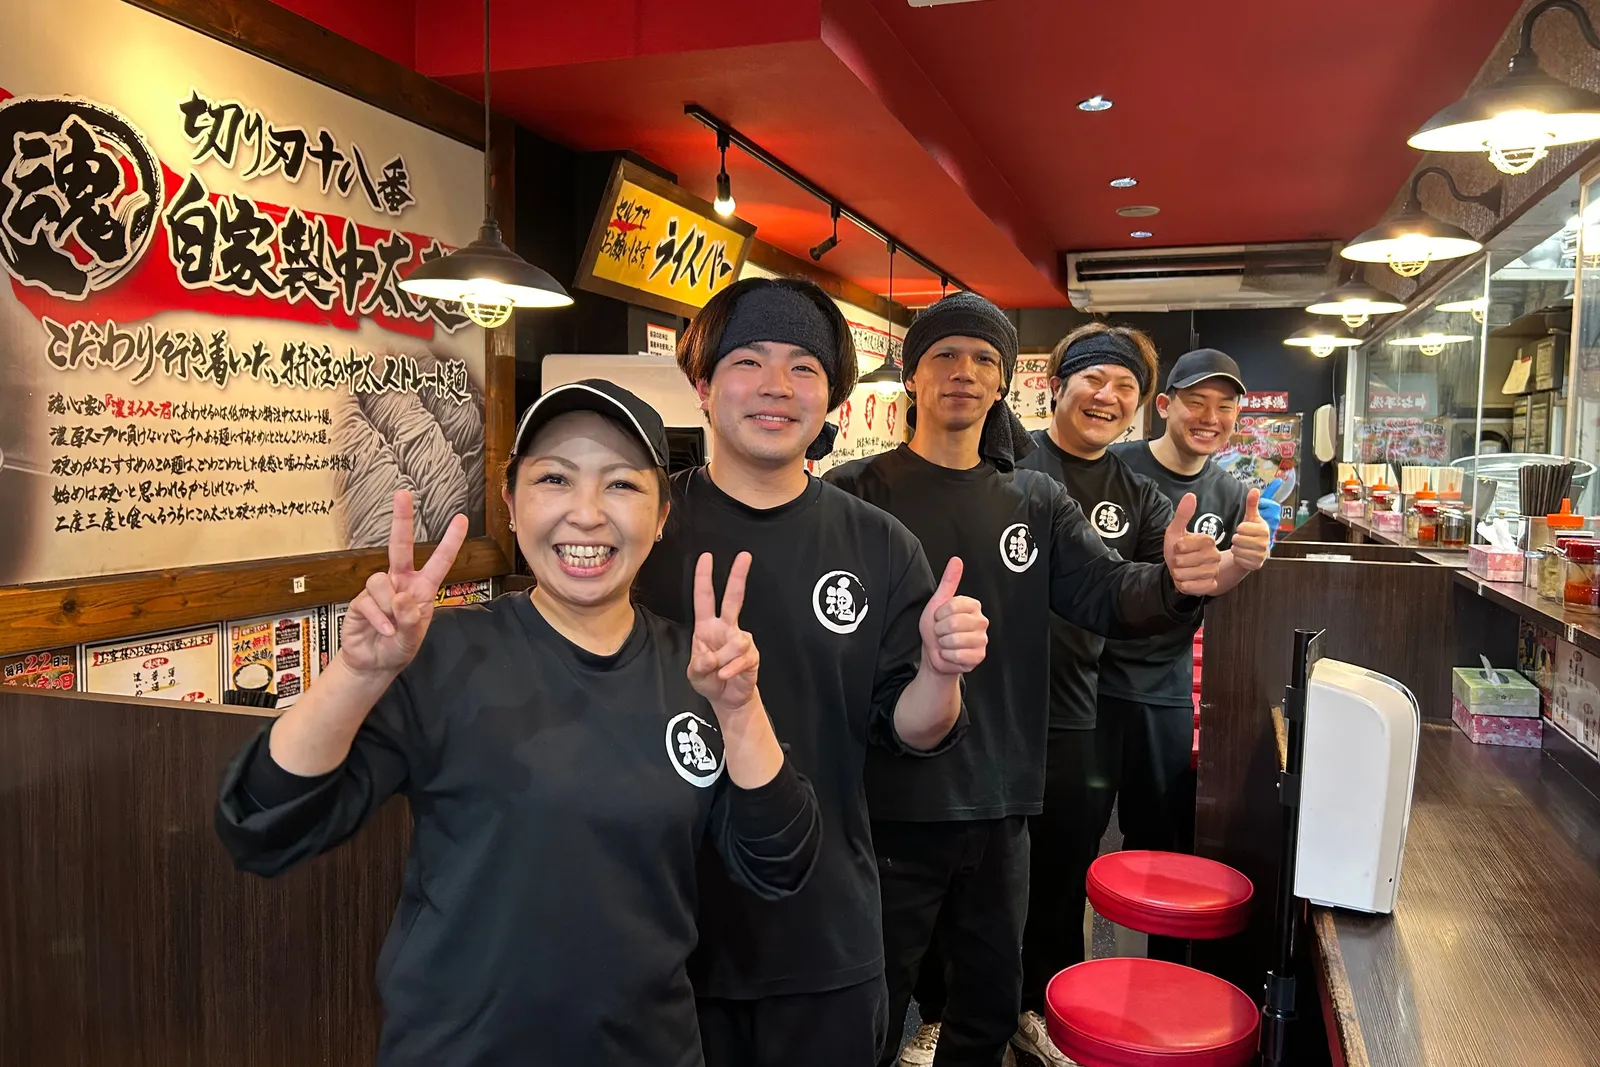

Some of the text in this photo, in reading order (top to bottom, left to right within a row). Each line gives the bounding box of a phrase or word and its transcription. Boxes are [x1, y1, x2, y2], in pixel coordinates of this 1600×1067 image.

[180, 91, 413, 211] 切り刃十八番
